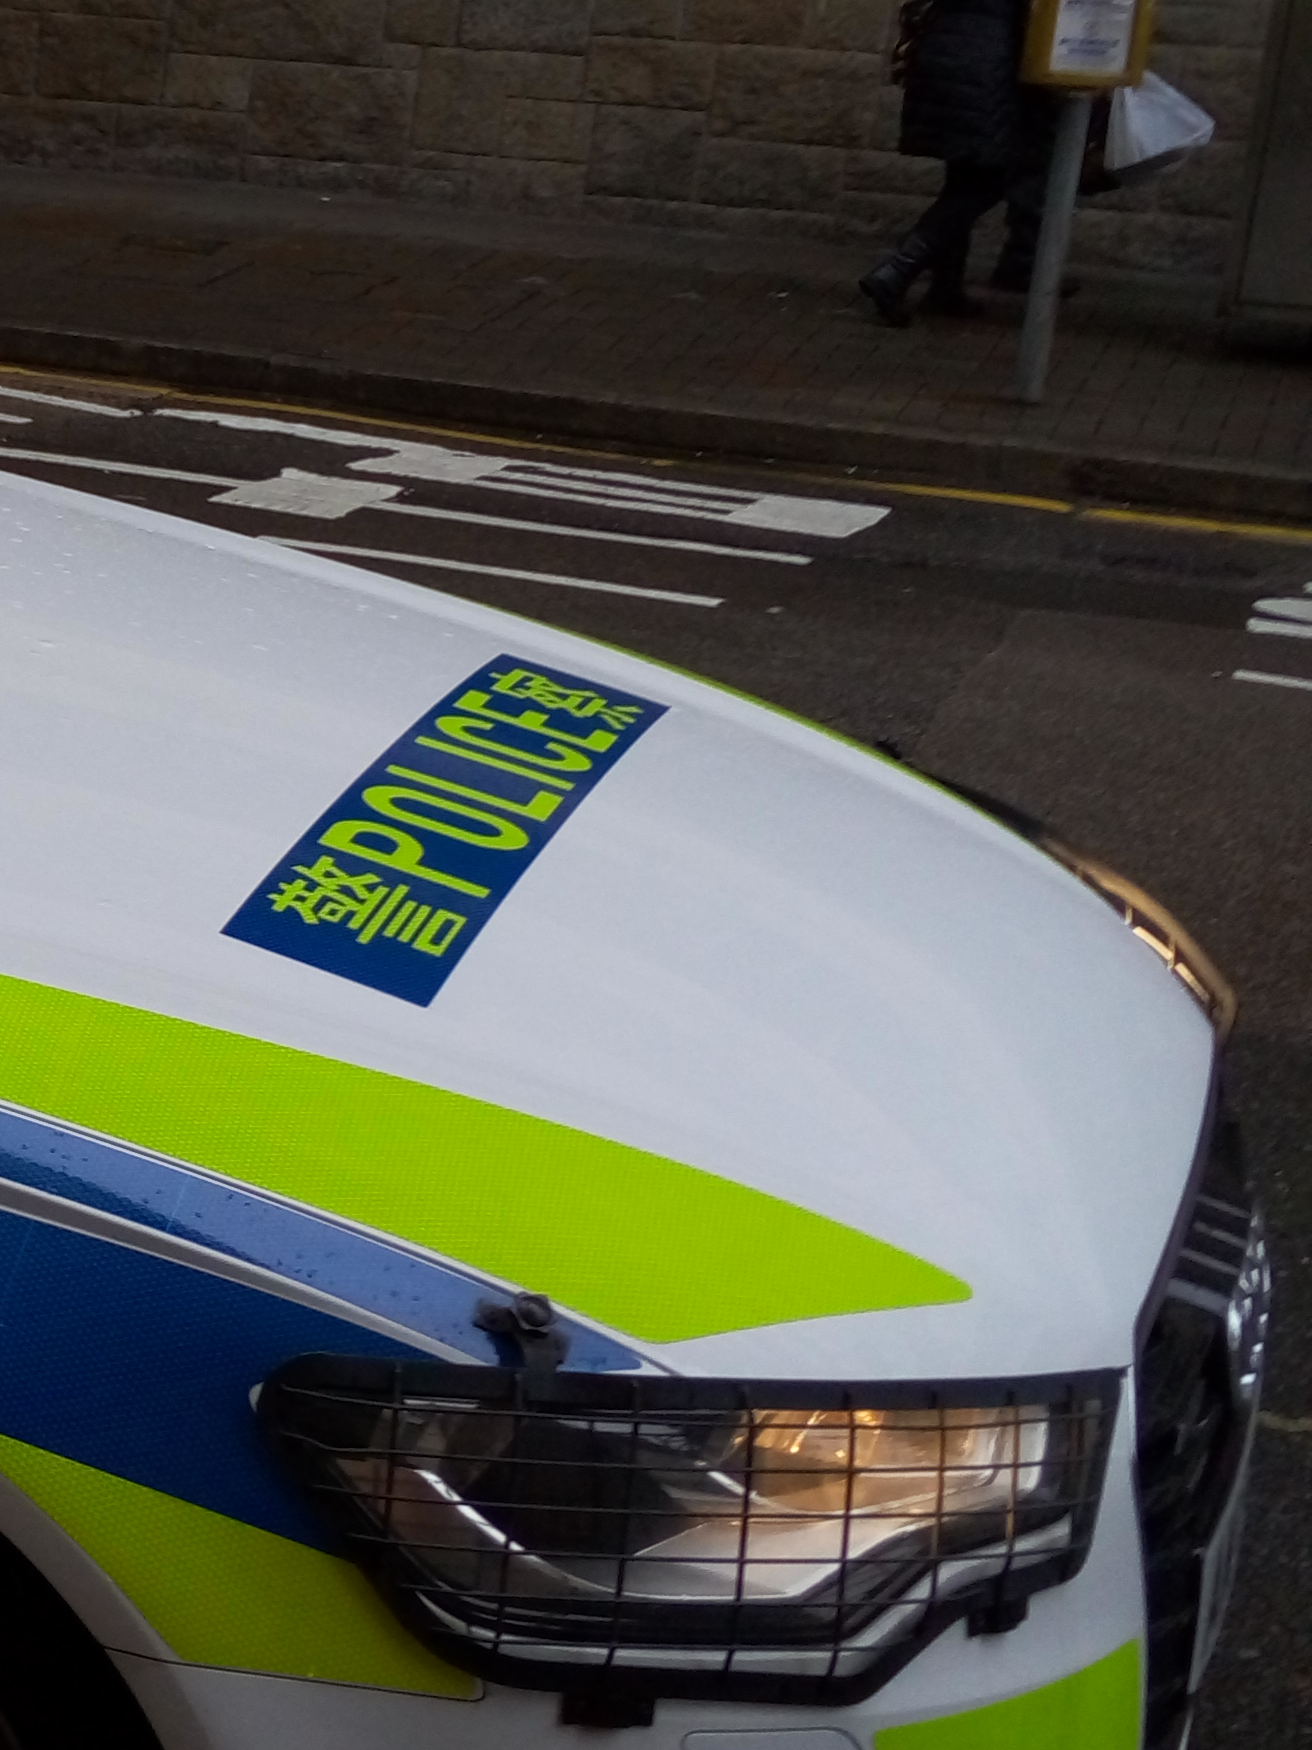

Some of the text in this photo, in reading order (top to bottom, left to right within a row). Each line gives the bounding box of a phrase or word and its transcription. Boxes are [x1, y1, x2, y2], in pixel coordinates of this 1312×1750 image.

[266, 667, 645, 958] 警 POLICE 察
